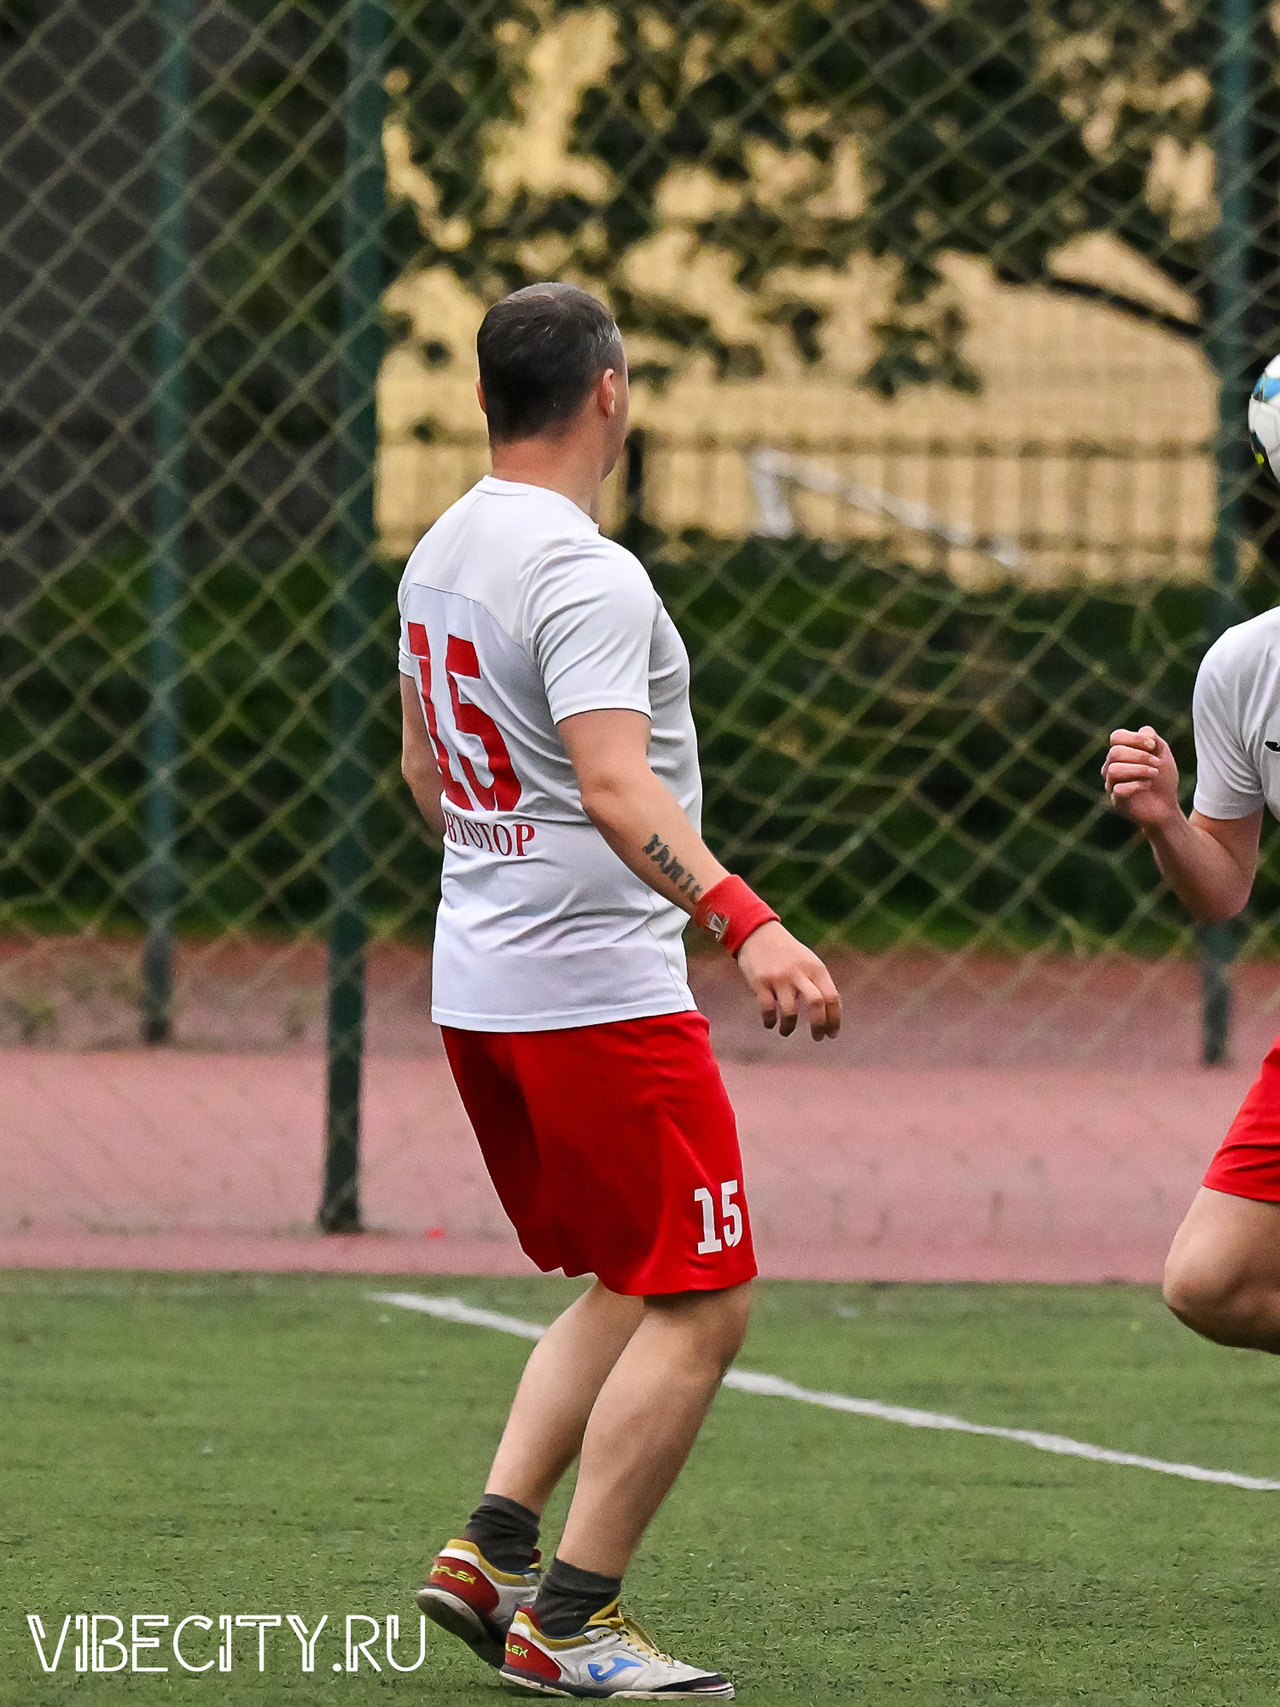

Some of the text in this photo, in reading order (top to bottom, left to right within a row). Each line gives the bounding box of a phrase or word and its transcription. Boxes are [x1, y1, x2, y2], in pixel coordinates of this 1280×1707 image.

[407, 620, 522, 813] 15
[444, 810, 536, 857] ВТОТОР
[694, 1179, 743, 1255] 15
